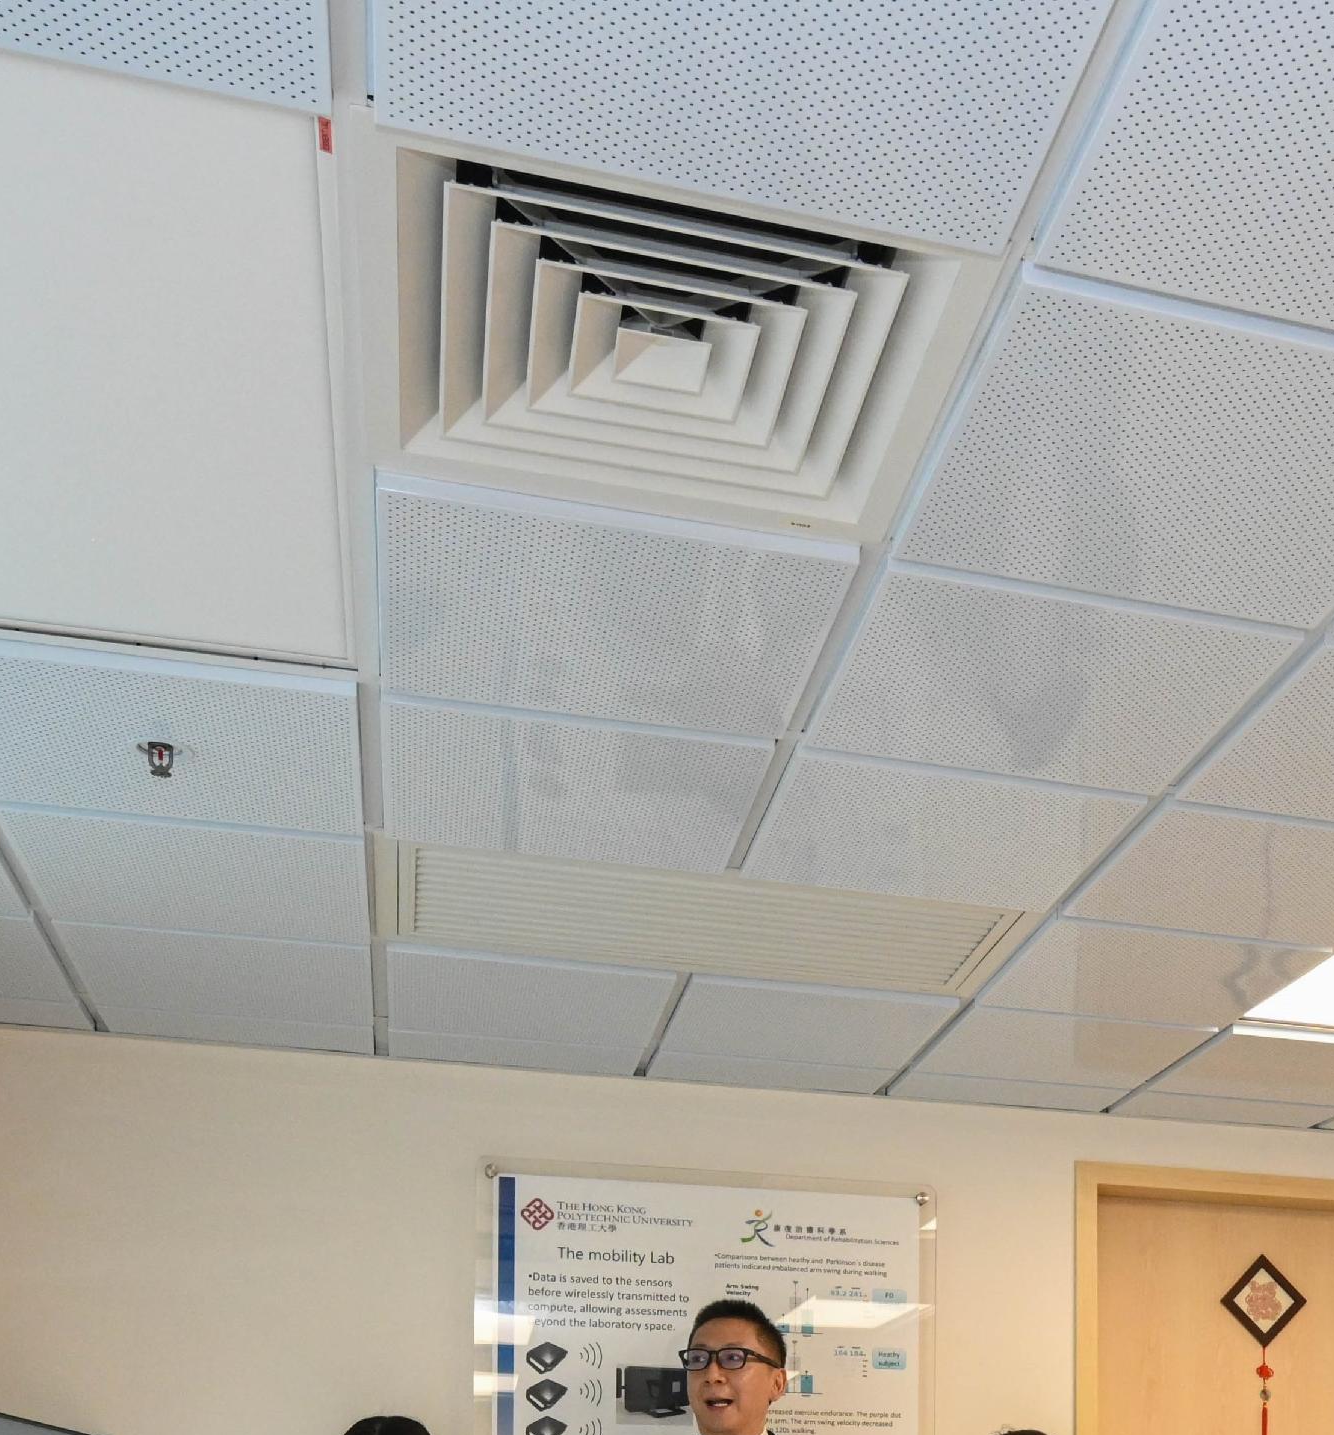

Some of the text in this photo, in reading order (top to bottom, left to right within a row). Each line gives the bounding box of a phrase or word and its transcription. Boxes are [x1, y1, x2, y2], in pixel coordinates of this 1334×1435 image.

[557, 1201, 647, 1215] THE HONG KONG
[557, 1211, 694, 1227] POLYTECHNIC UNIVERSITY
[557, 1221, 618, 1232] 香港理工大學
[557, 1246, 675, 1267] The mobility Lab
[559, 1273, 567, 1283] is
[570, 1274, 599, 1285] saved
[602, 1275, 613, 1286] to
[616, 1276, 632, 1287] the
[635, 1278, 673, 1288] sensors
[842, 1267, 863, 1278] during
[864, 1268, 887, 1279] walking
[528, 1286, 690, 1304] before wirelessly transmitted to
[528, 1302, 688, 1318] compute, allowing assessments
[534, 1316, 675, 1333] eyond the laboratory space.
